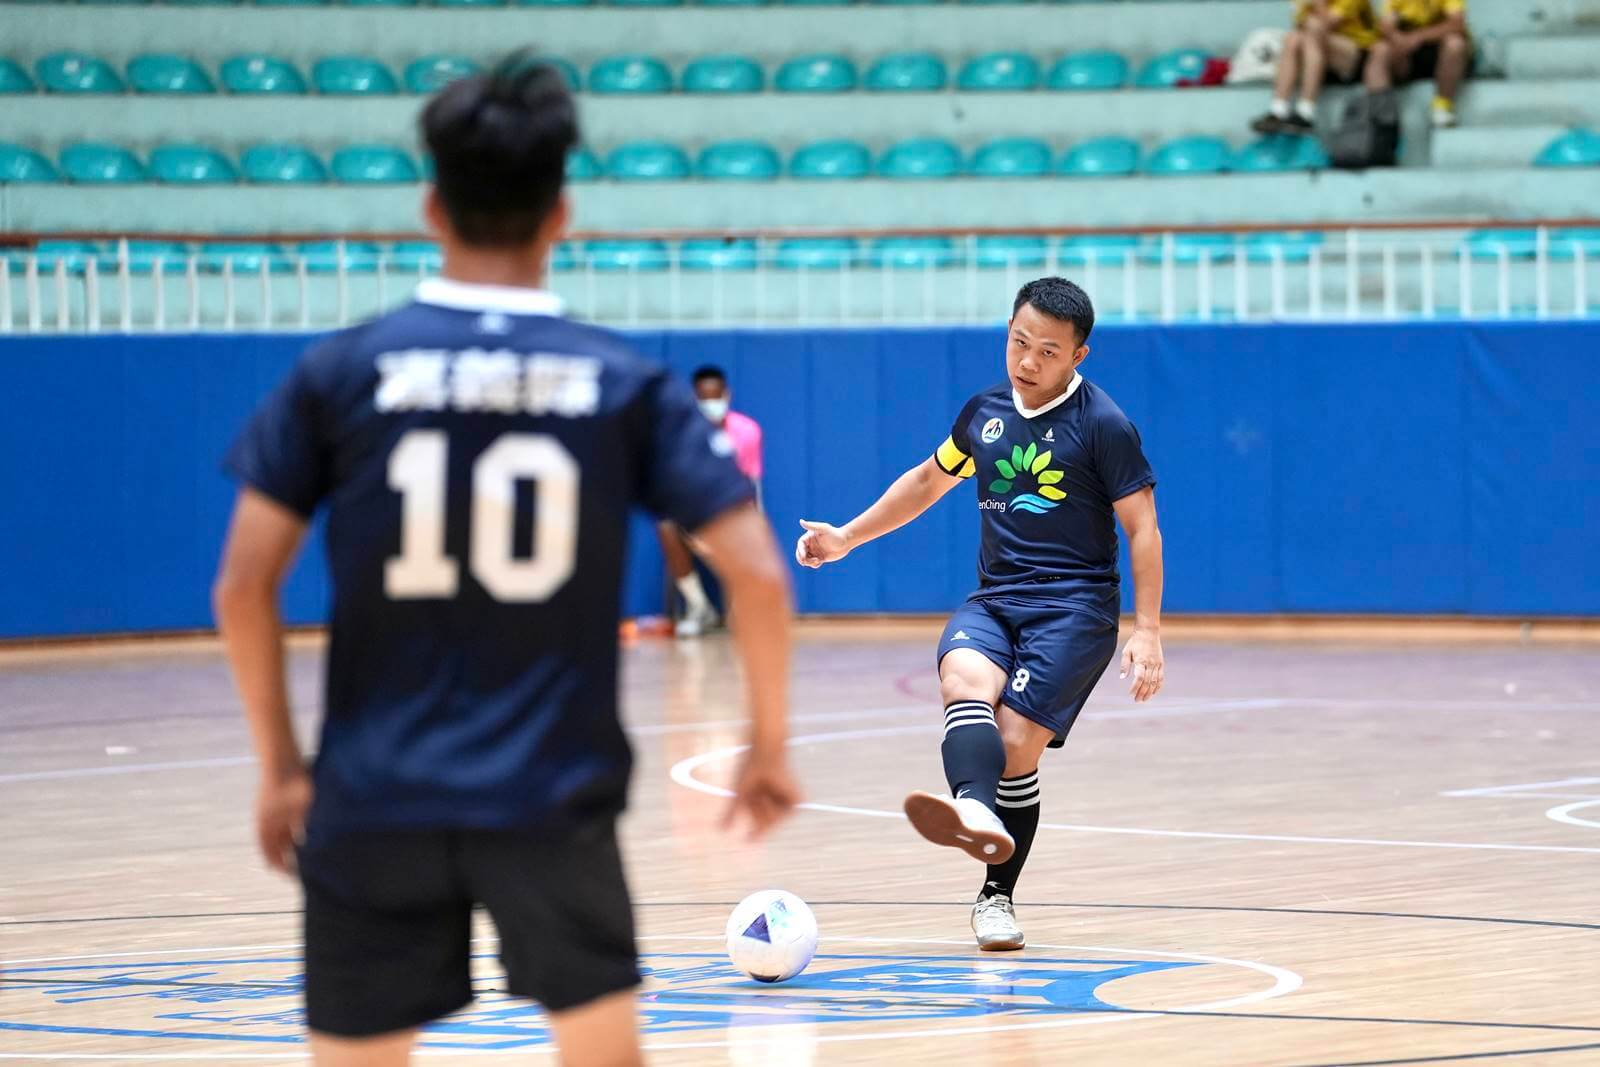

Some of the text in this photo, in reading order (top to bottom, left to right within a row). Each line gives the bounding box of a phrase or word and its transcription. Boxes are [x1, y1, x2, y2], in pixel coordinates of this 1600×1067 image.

[385, 430, 579, 602] 10
[978, 498, 1006, 513] enChing
[1012, 668, 1030, 692] 8
